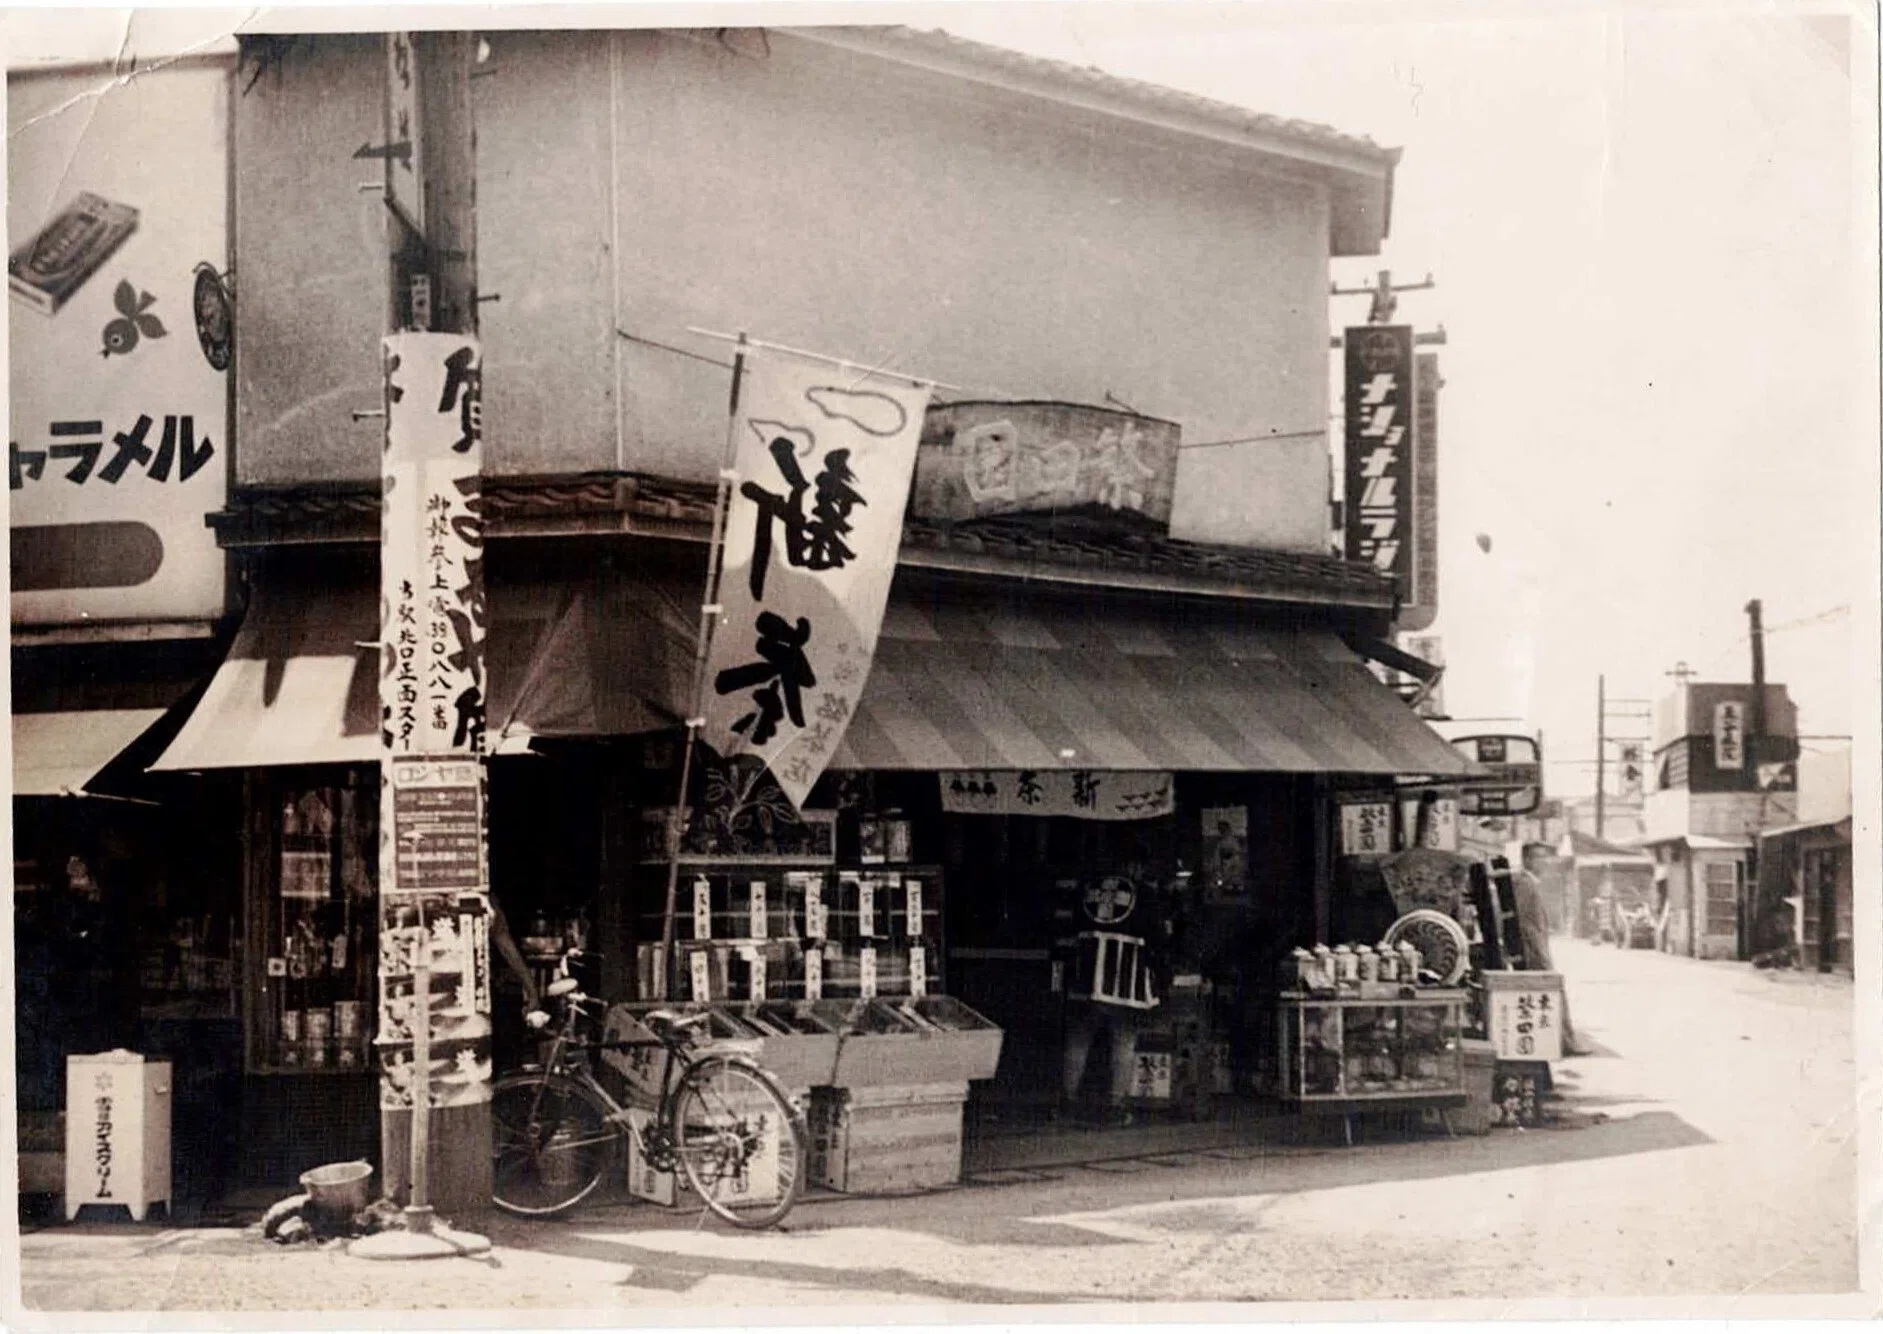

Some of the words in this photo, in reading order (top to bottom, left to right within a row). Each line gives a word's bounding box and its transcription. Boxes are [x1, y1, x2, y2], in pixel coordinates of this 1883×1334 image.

[1359, 373, 1405, 578] ナショナルラジ
